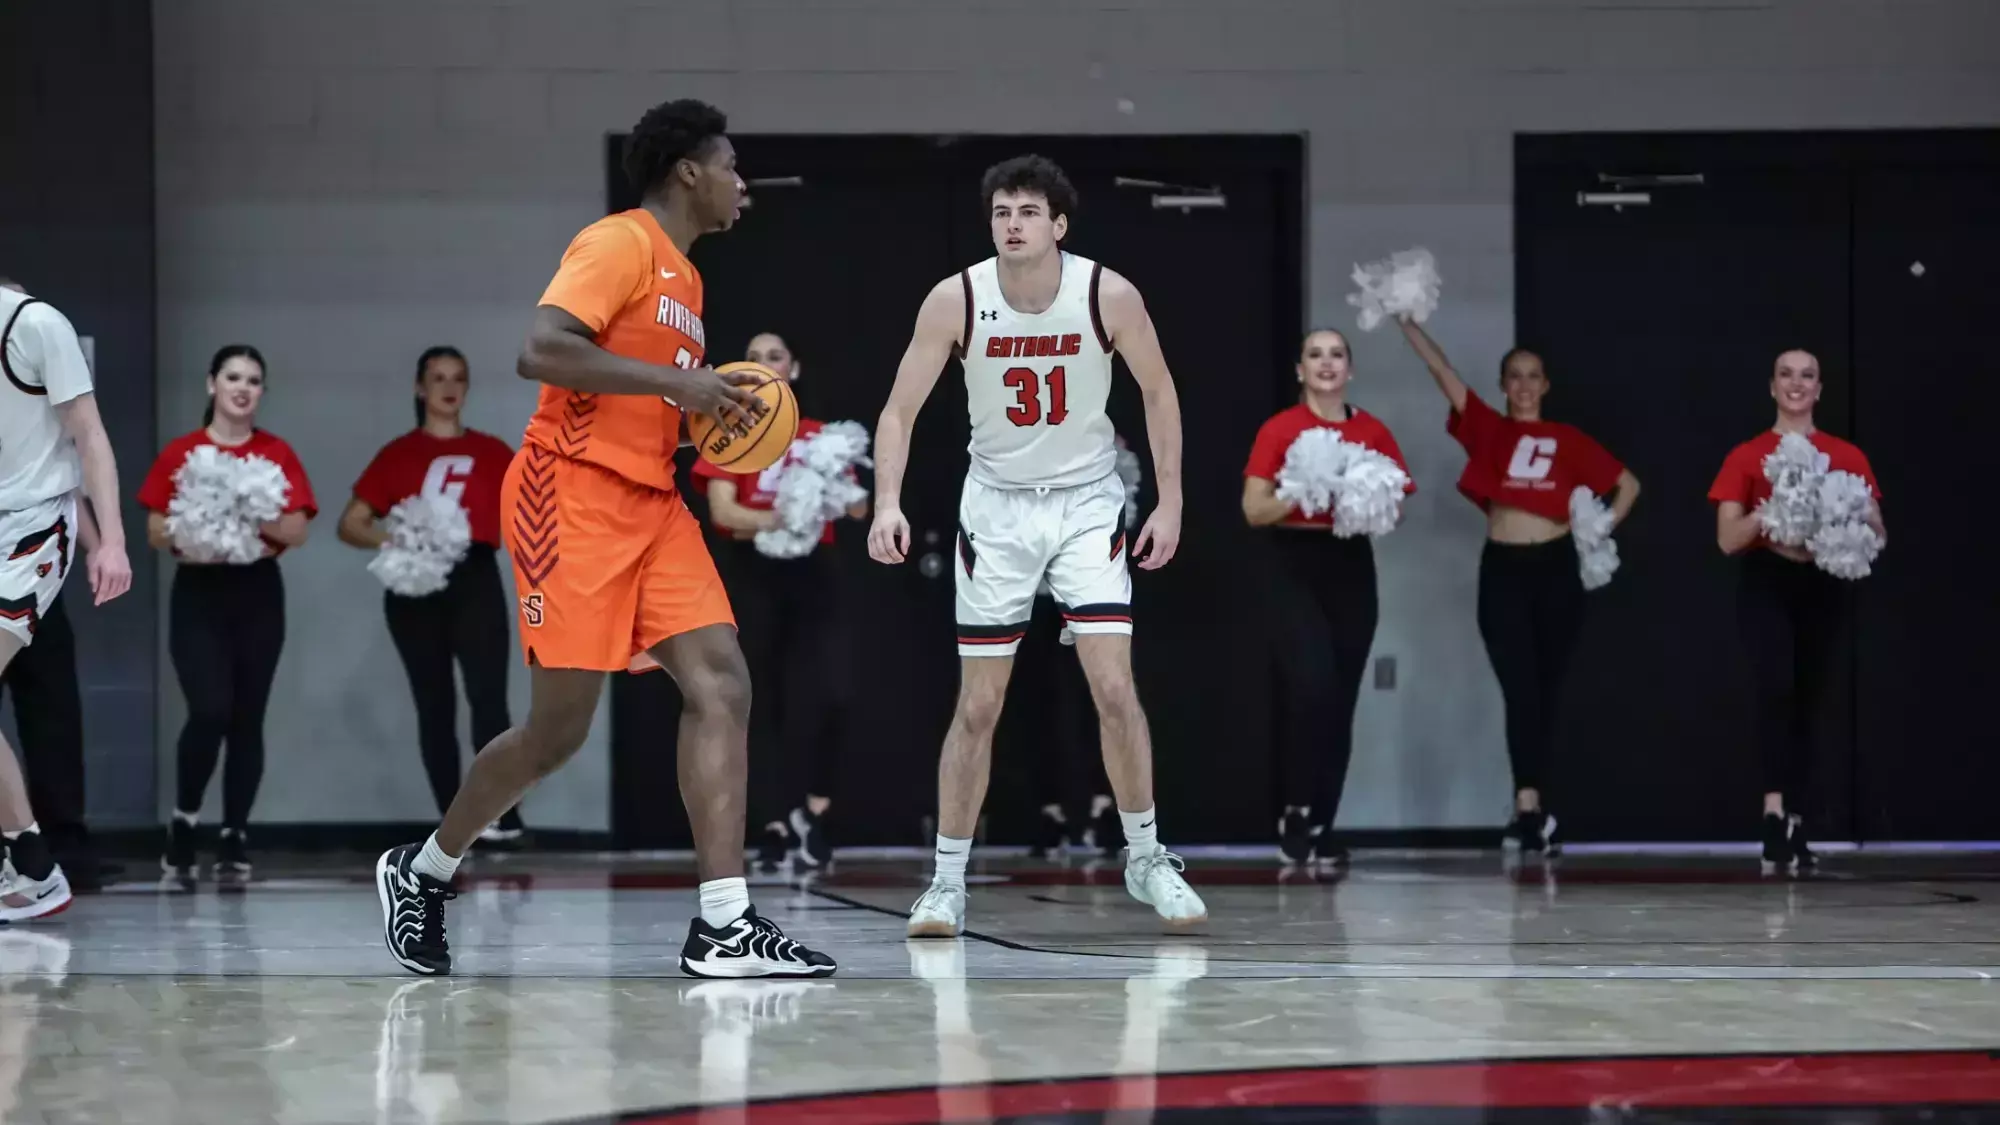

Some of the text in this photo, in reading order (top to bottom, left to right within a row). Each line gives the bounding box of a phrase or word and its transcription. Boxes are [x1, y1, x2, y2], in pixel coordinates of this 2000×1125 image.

[986, 333, 1081, 358] CATHOLIC
[1003, 366, 1069, 427] 31
[420, 454, 475, 503] C
[1508, 434, 1557, 479] C
[520, 593, 543, 627] S
